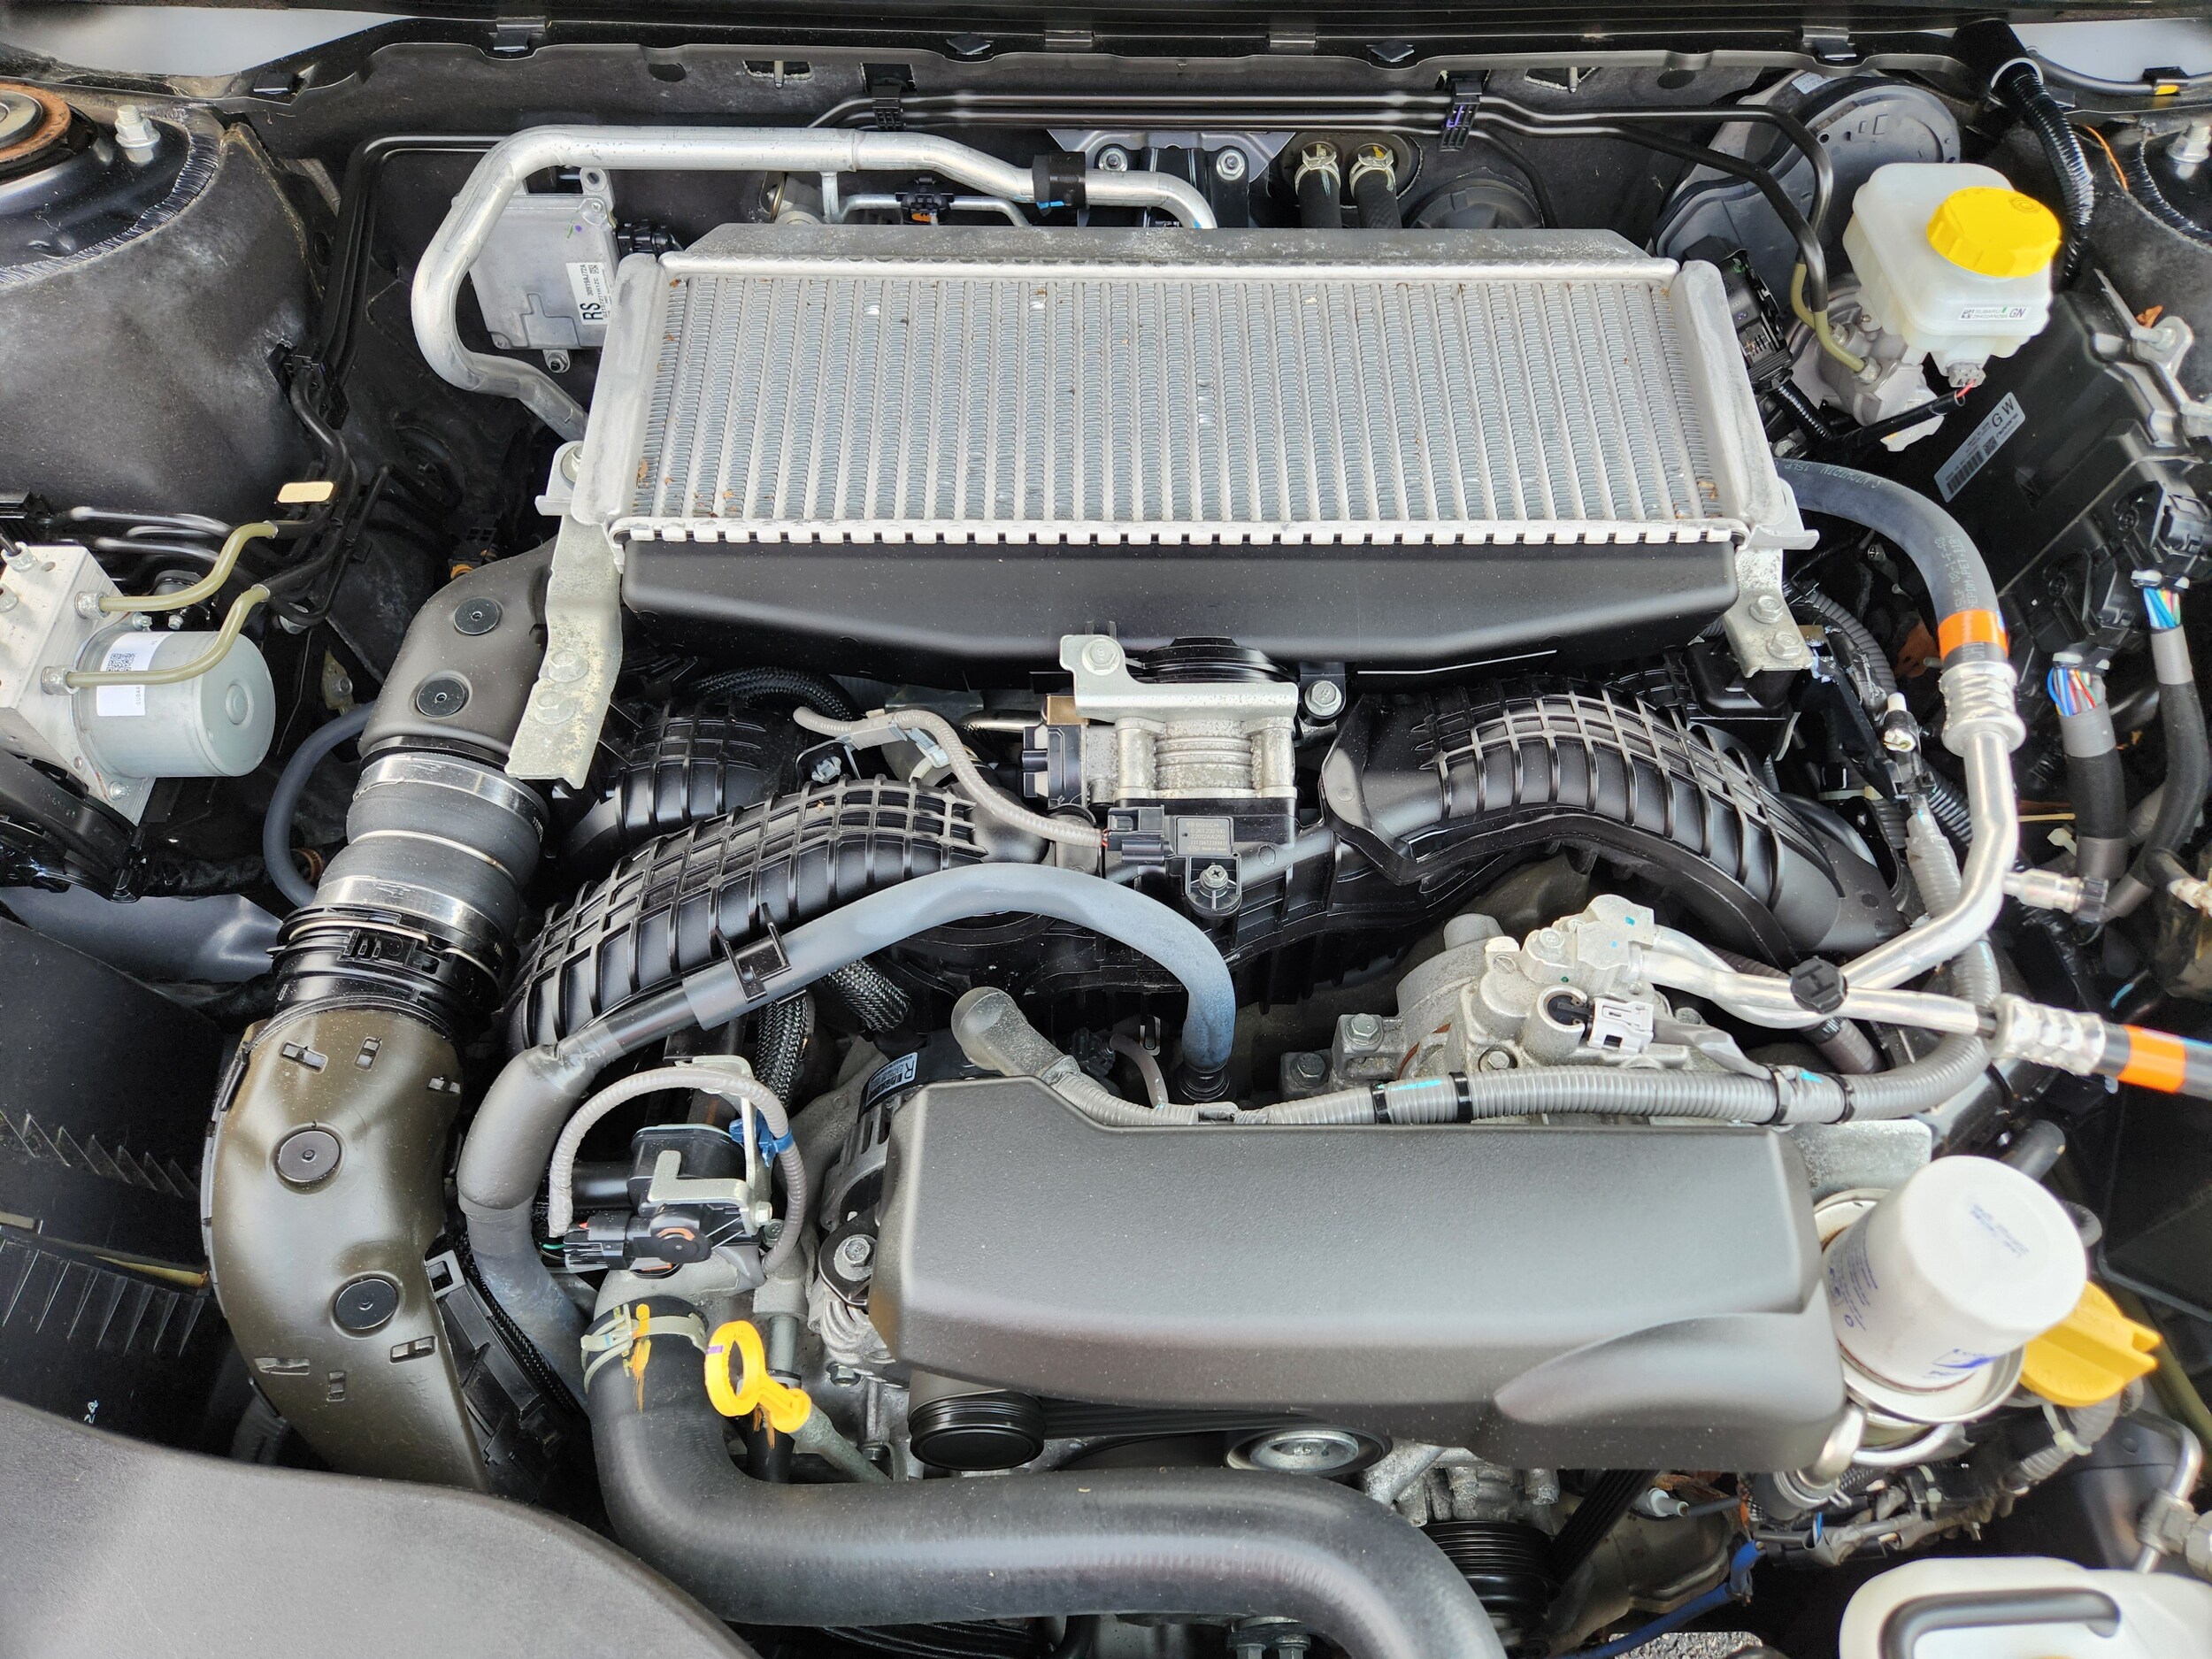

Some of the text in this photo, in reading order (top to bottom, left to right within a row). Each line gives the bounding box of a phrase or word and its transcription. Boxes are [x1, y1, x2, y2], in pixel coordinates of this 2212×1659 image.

[580, 303, 604, 320] RS
[2009, 308, 2026, 319] GN
[904, 1060, 915, 1079] R
